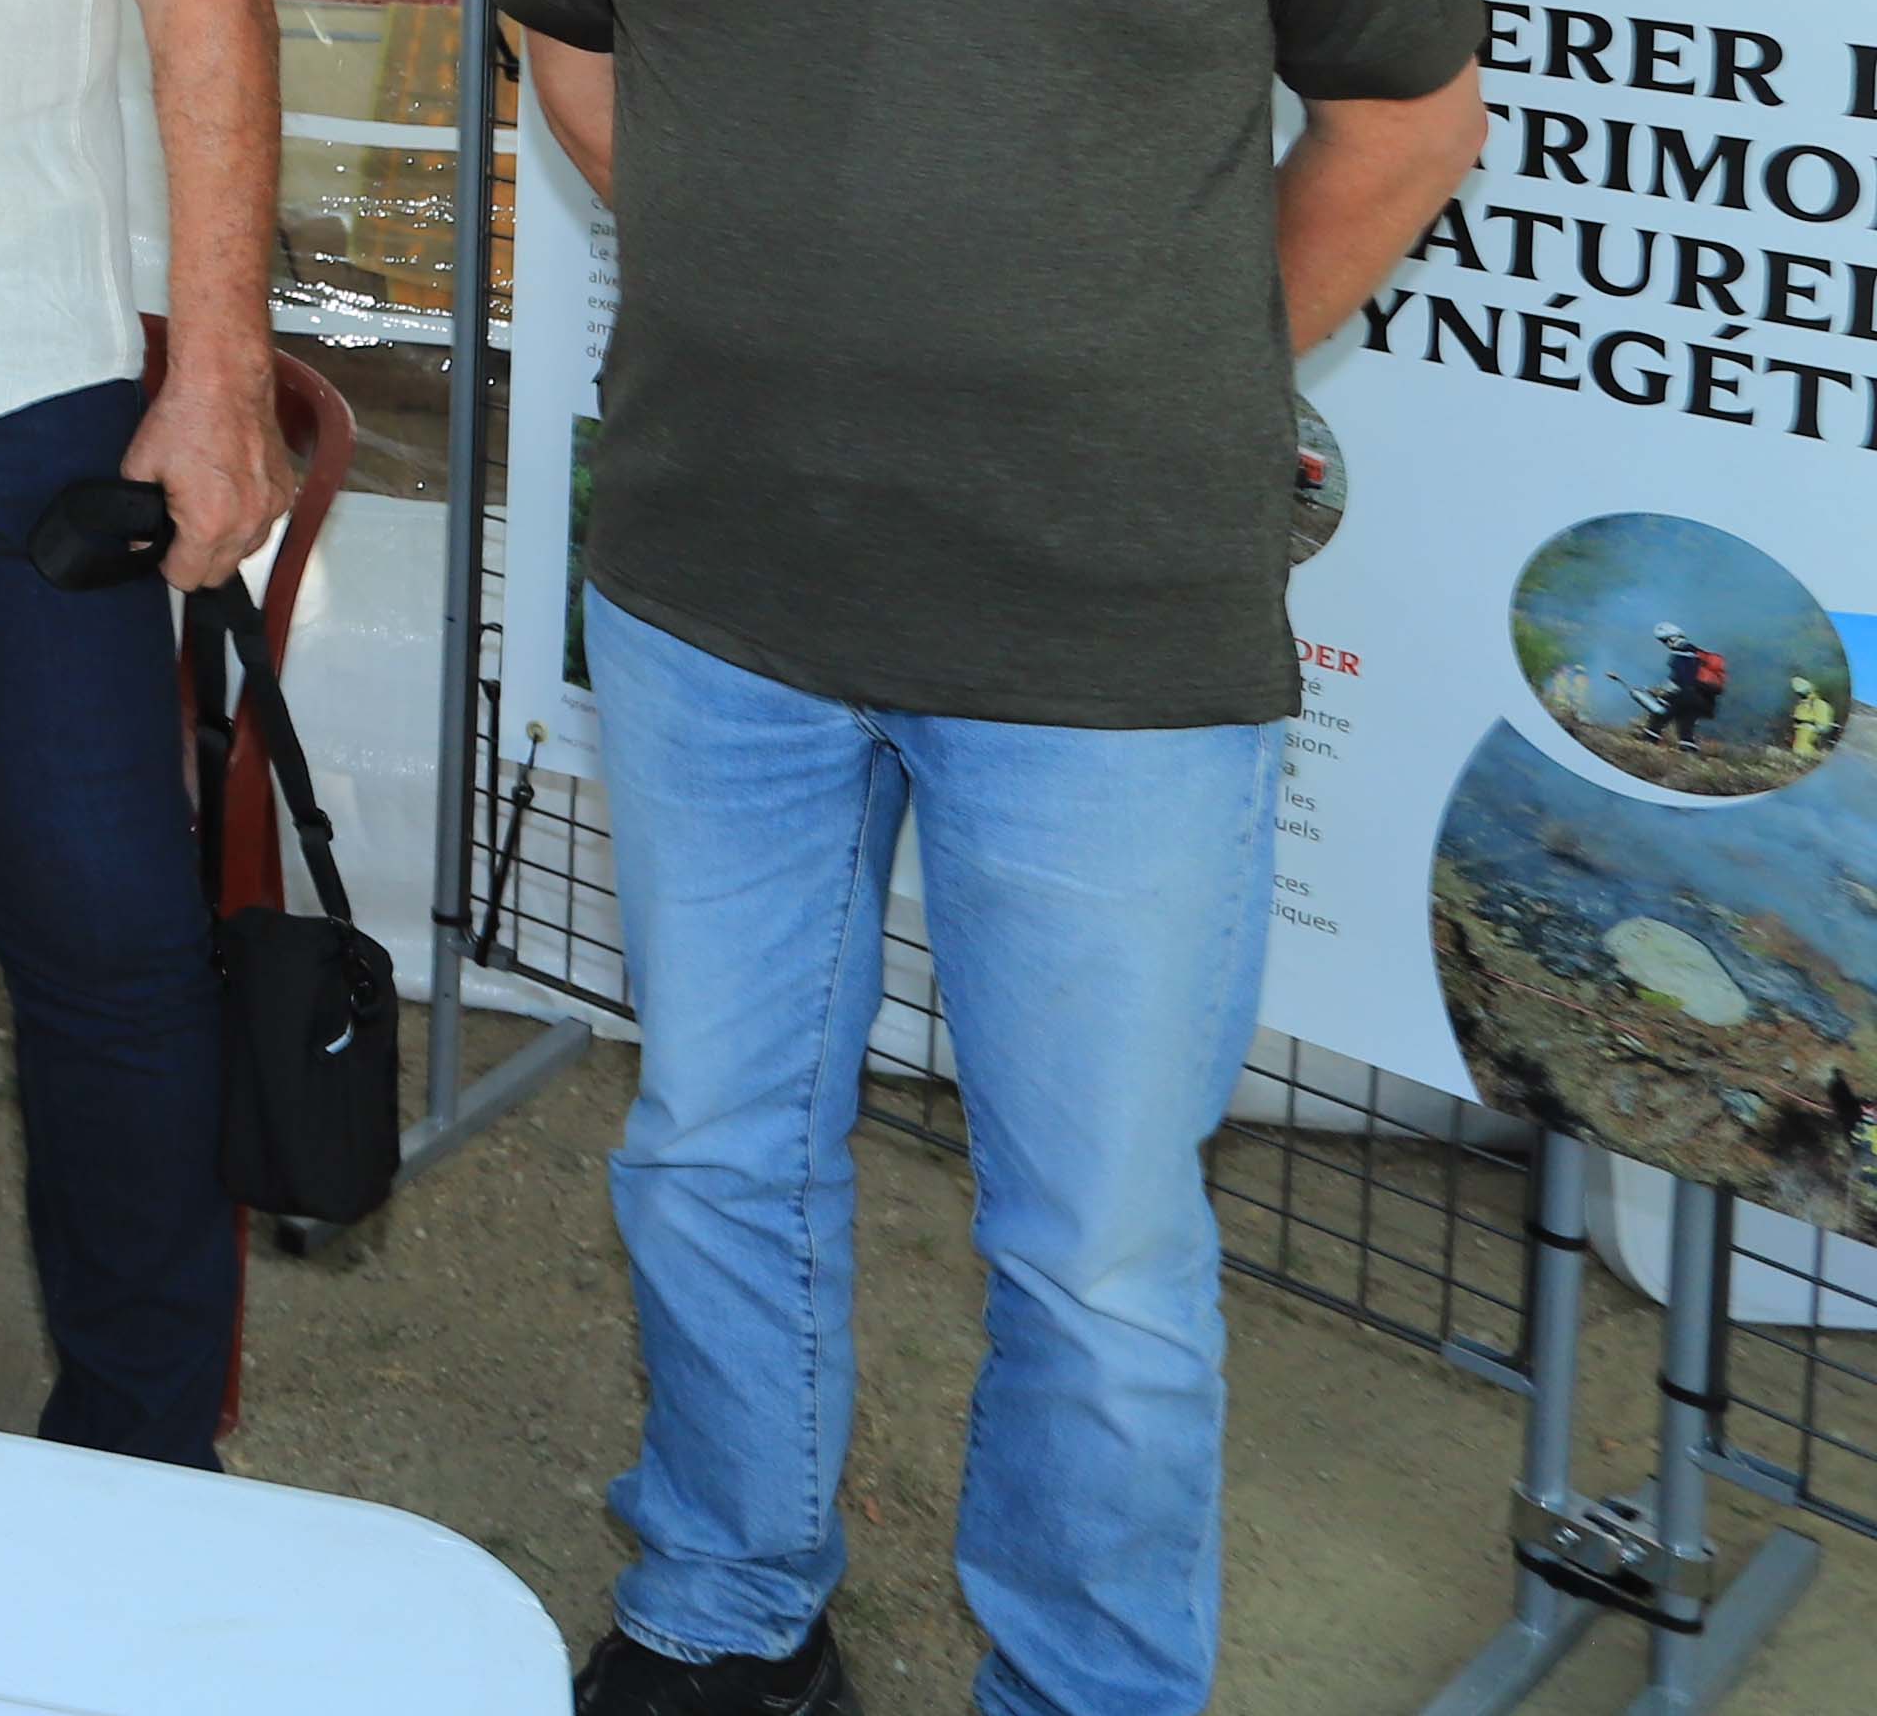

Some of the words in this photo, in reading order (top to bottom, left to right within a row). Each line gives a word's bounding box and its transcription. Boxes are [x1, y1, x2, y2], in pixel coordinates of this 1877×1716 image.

[1473, 103, 1877, 231] RIMO
[1406, 198, 1877, 341] ATURE
[1358, 289, 1877, 452] YNÉGÉT
